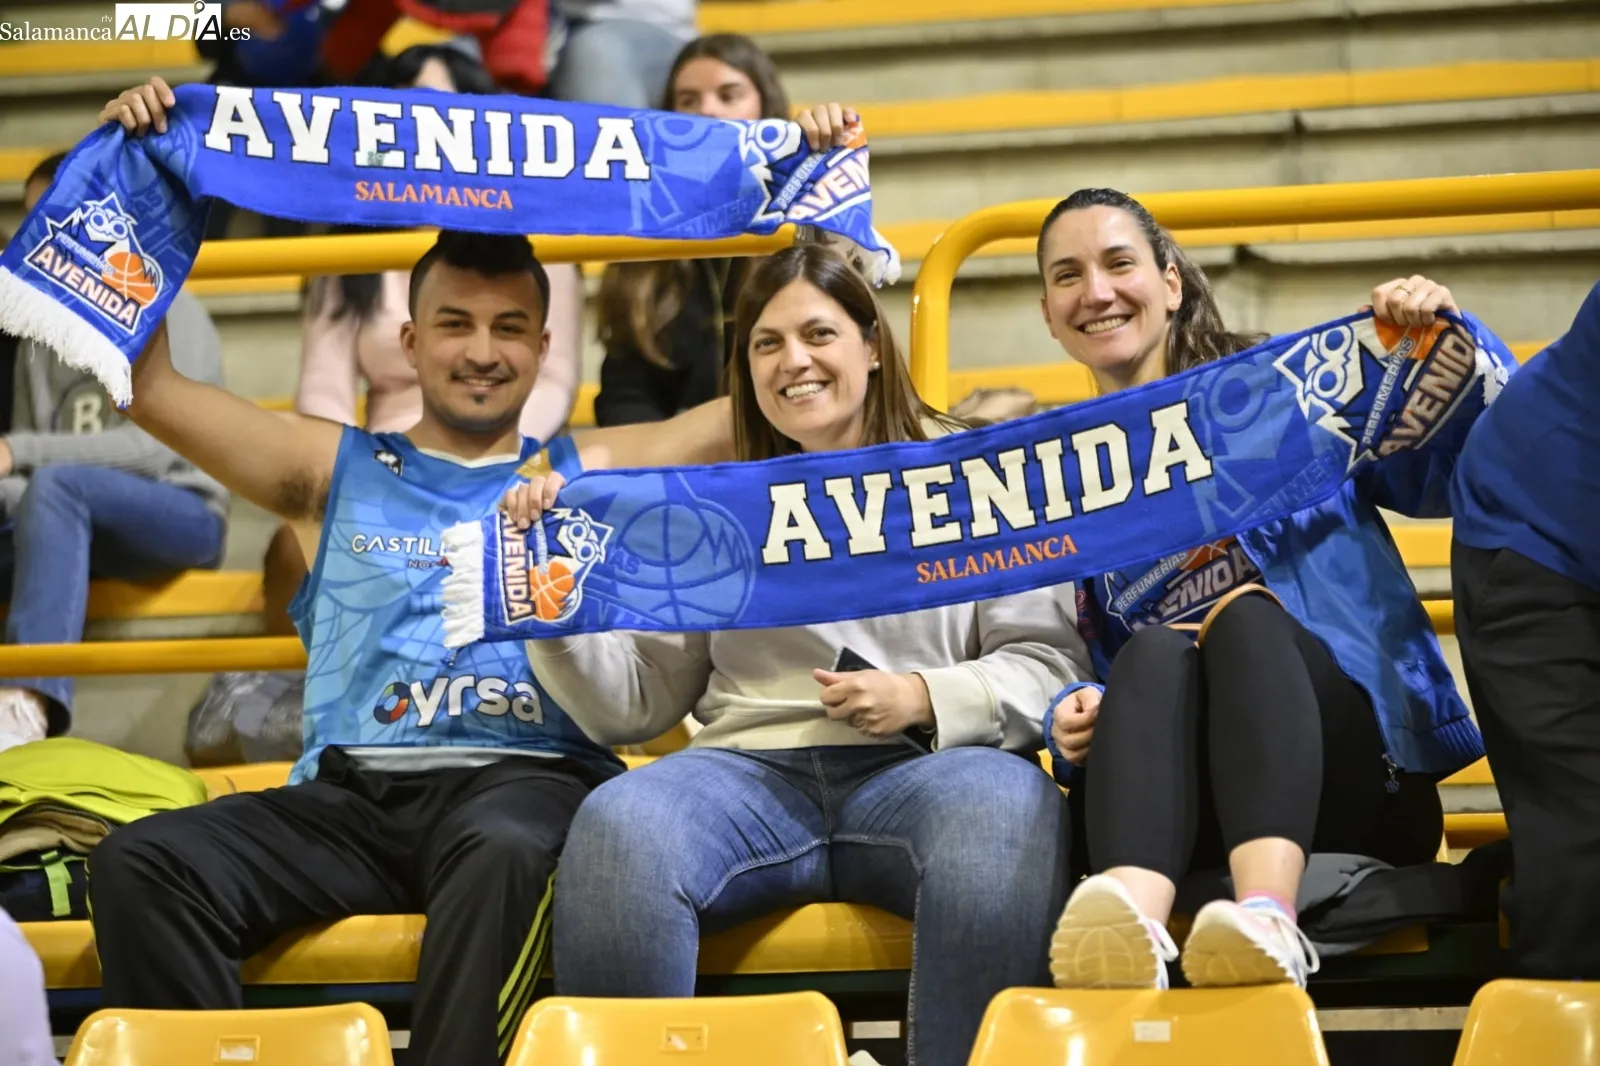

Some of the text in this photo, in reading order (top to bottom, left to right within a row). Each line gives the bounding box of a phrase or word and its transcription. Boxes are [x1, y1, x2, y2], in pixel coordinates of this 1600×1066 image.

[204, 85, 651, 181] AVENIDA
[354, 180, 513, 210] SALAMANCA
[776, 150, 827, 210] PERFUM
[785, 152, 869, 221] AVEN
[35, 245, 139, 325] AVENIDA
[759, 400, 1214, 565] AVENIDA
[916, 533, 1078, 585] SALAMANCA
